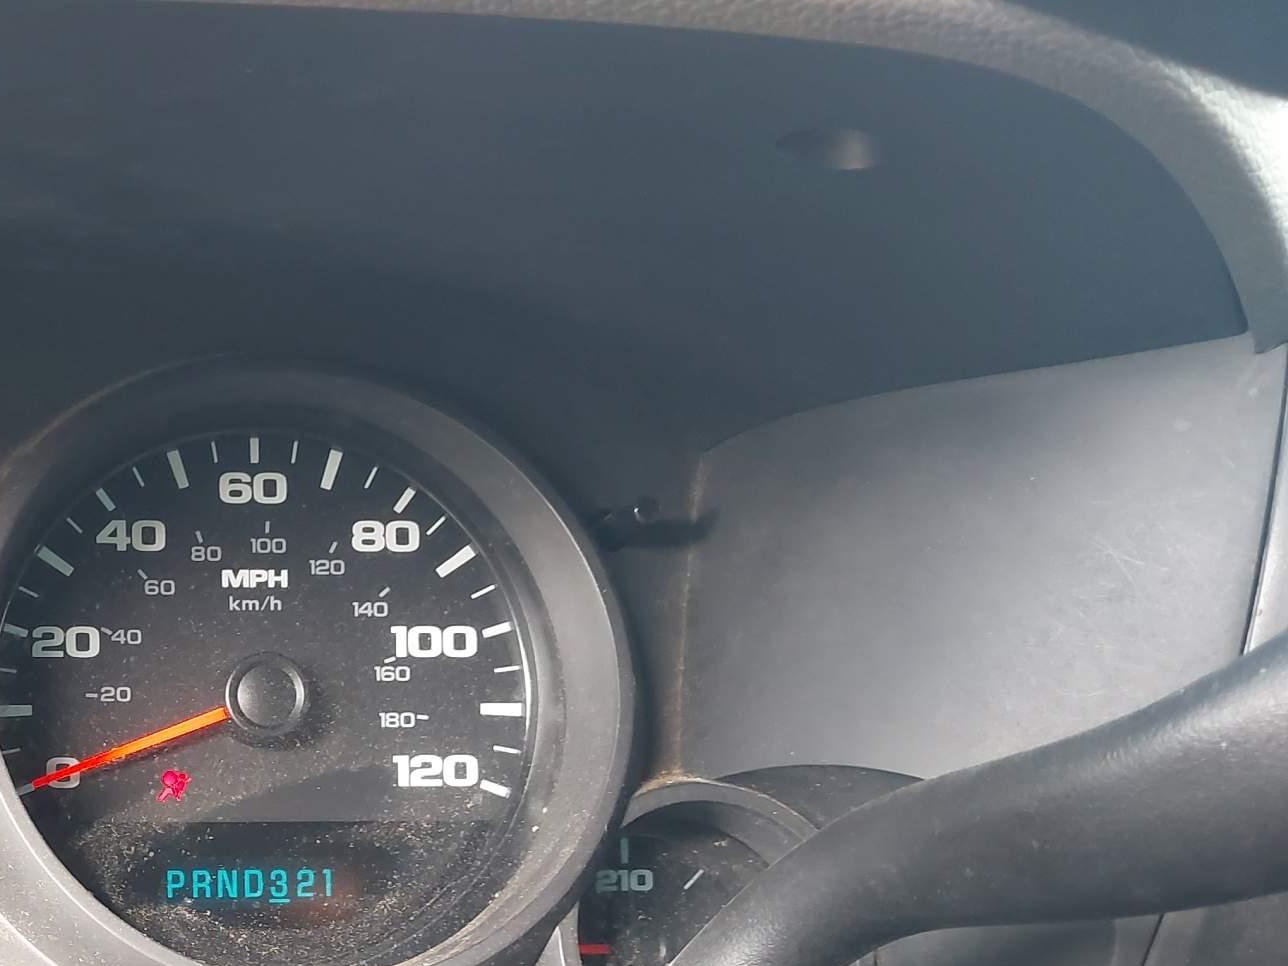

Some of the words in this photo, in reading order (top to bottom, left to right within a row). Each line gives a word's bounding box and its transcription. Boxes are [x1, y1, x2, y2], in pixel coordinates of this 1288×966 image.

[219, 472, 288, 505] 60
[96, 519, 166, 552] 40
[351, 519, 420, 553] 80
[190, 545, 222, 562] 80
[249, 537, 287, 554] 100
[309, 558, 345, 576] 120
[143, 578, 176, 596] 60
[220, 568, 289, 590] MPH
[228, 594, 283, 612] km/h
[351, 600, 389, 618] 140
[31, 625, 101, 659] 20
[110, 628, 142, 645] 40
[390, 625, 478, 659] 100
[373, 665, 411, 682] 160
[98, 686, 132, 703] 20
[378, 711, 415, 728] 180
[45, 756, 81, 789] 0
[392, 754, 479, 789] 120
[595, 868, 654, 892] 210
